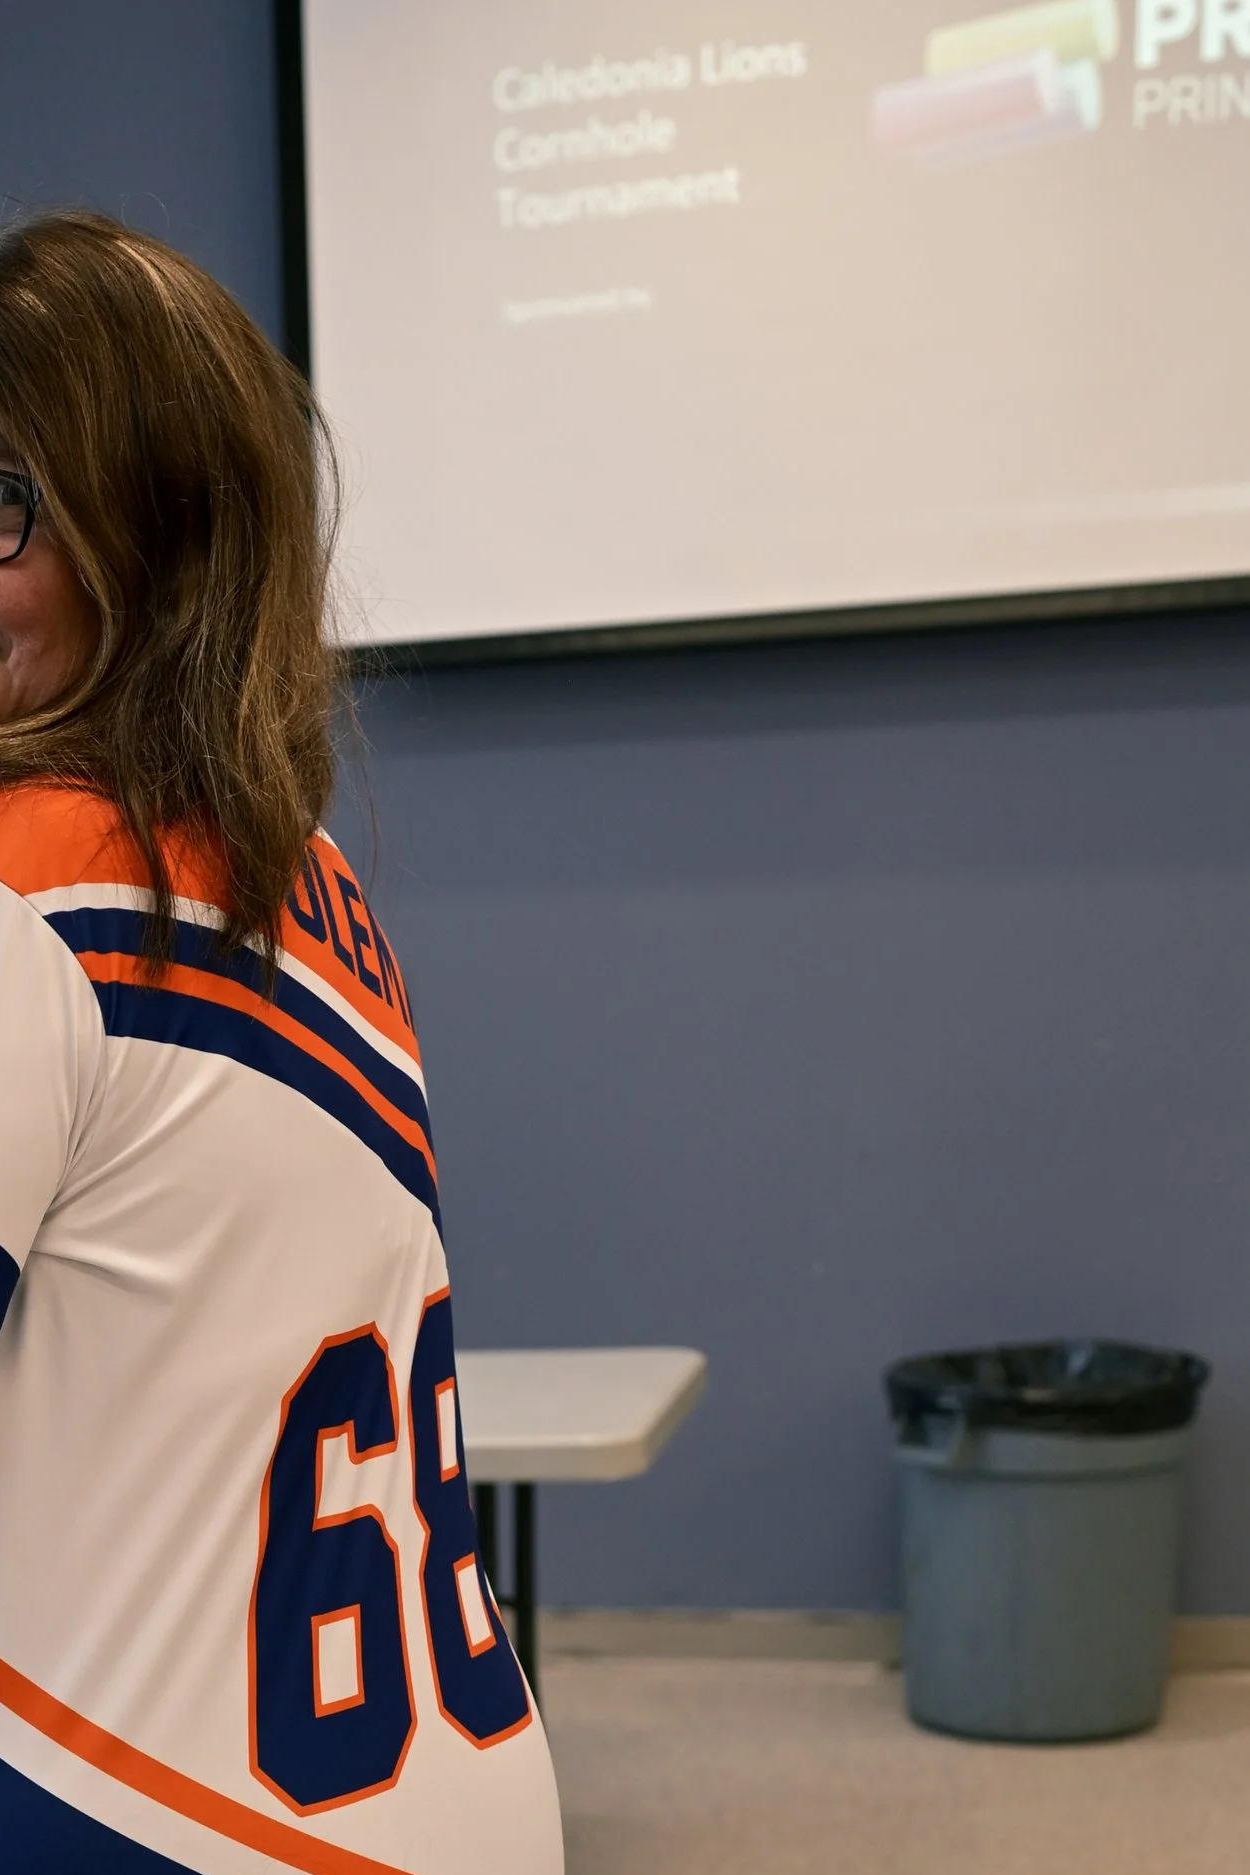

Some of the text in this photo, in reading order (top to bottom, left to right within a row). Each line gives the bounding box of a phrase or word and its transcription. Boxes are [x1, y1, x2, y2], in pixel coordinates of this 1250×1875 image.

[494, 42, 807, 110] Caledonia Lions
[493, 110, 676, 171] Cornhole
[498, 166, 739, 227] Tournament
[248, 1285, 533, 1818] 68
